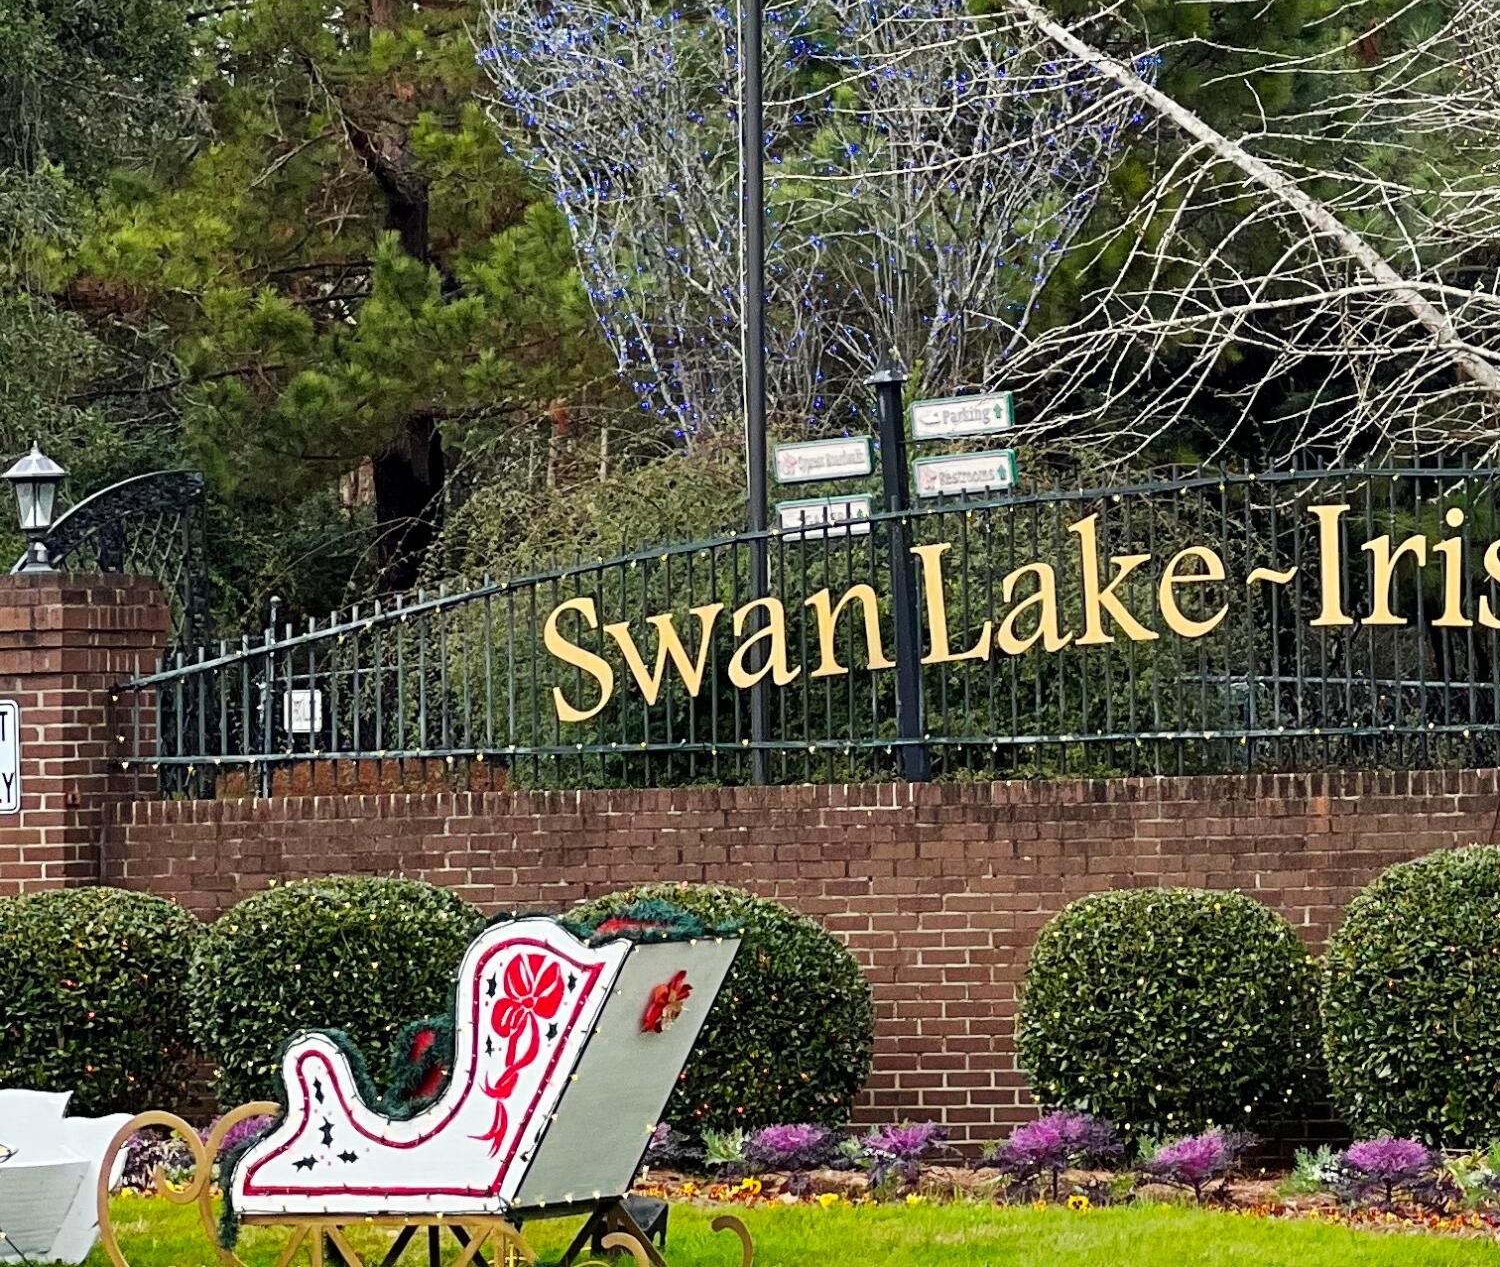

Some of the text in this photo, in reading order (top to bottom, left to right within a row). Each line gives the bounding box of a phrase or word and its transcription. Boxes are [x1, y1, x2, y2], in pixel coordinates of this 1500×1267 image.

[942, 406, 991, 425] Parking
[543, 583, 897, 722] Swan
[910, 513, 1229, 664] Lake
